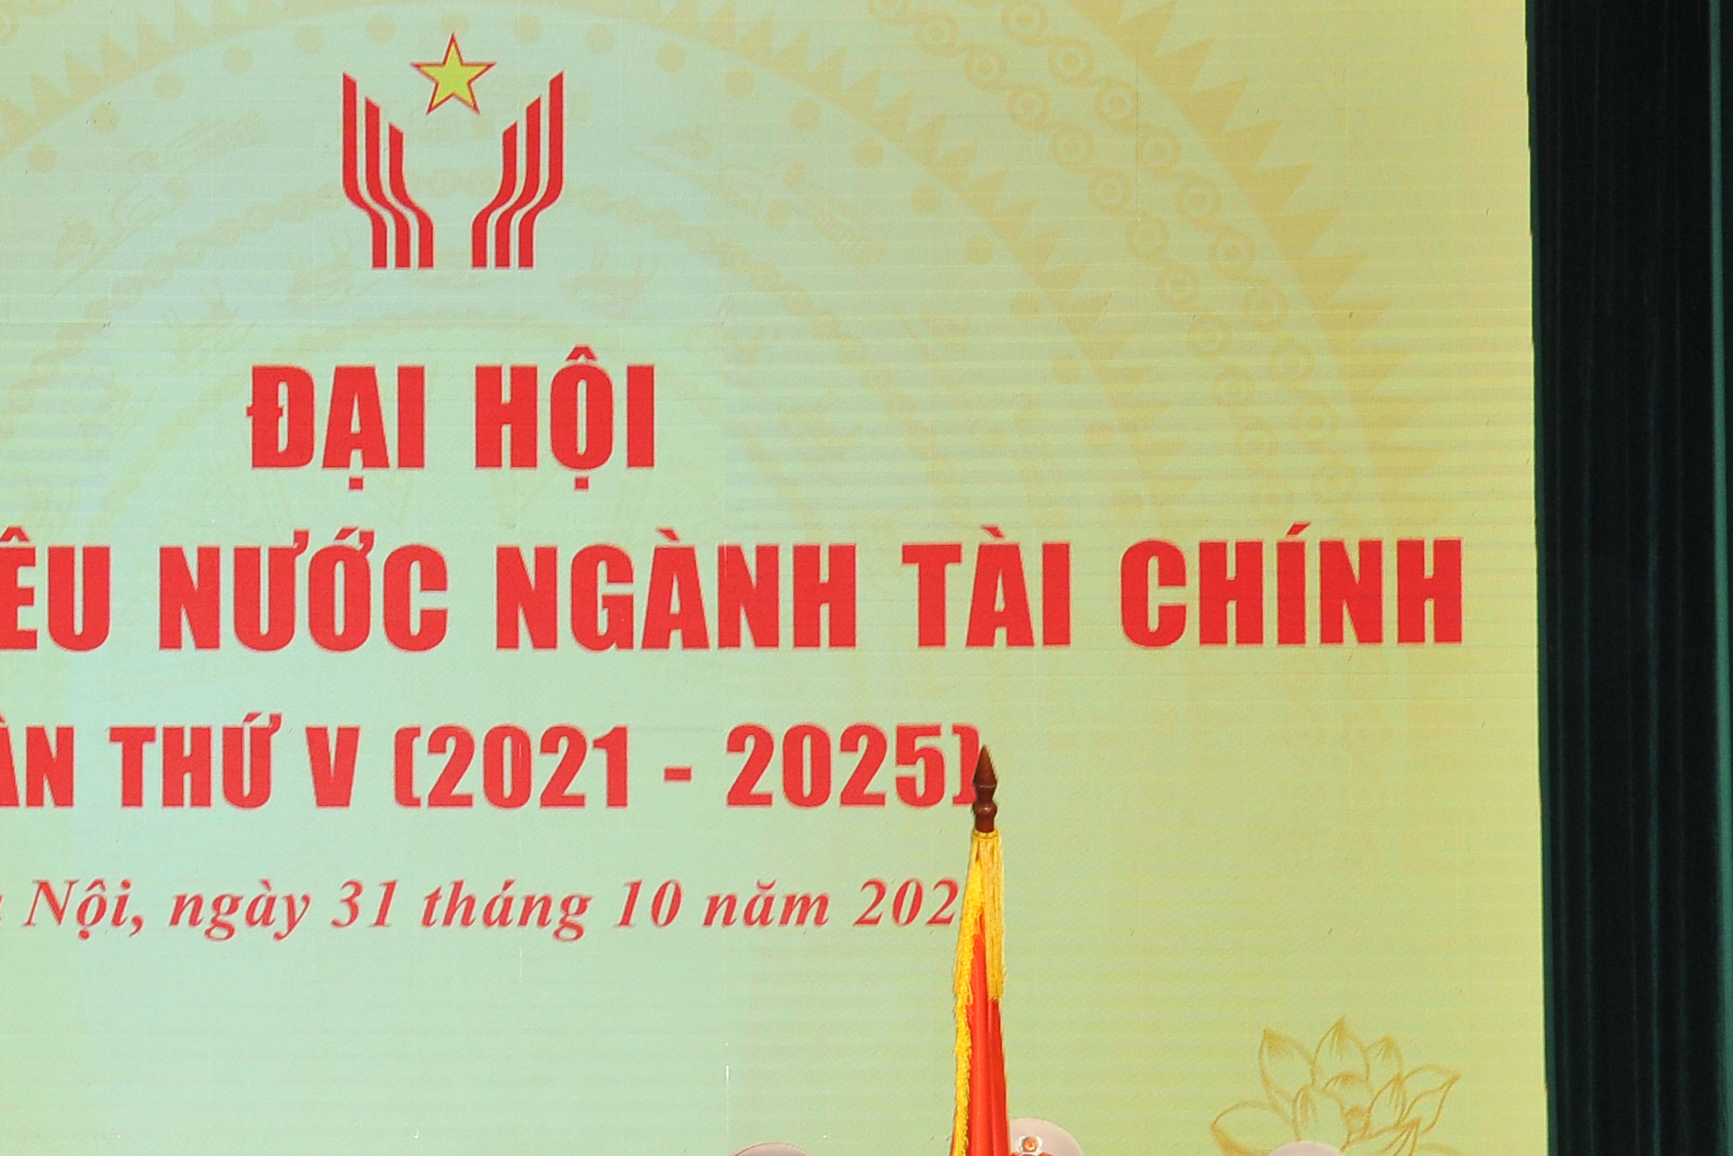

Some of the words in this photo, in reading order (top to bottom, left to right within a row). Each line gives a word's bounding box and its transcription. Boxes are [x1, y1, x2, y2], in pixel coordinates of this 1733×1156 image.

[246, 364, 425, 492] ĐẠI
[474, 345, 655, 492] HỘI
[159, 526, 448, 652] NƯỚC
[495, 529, 857, 651] NGÀNH
[901, 526, 1071, 648] TÀI
[1120, 521, 1463, 648] CHÍNH
[109, 712, 282, 809] THỨ
[305, 726, 360, 807] V
[393, 725, 629, 809] (2021
[663, 767, 692, 782] -
[25, 879, 144, 941] Nội,
[170, 879, 310, 941] ngày
[331, 880, 396, 927] 31
[421, 879, 591, 941] tháng
[617, 880, 682, 927] 10
[703, 880, 830, 927] năm
[854, 878, 960, 926] 202
